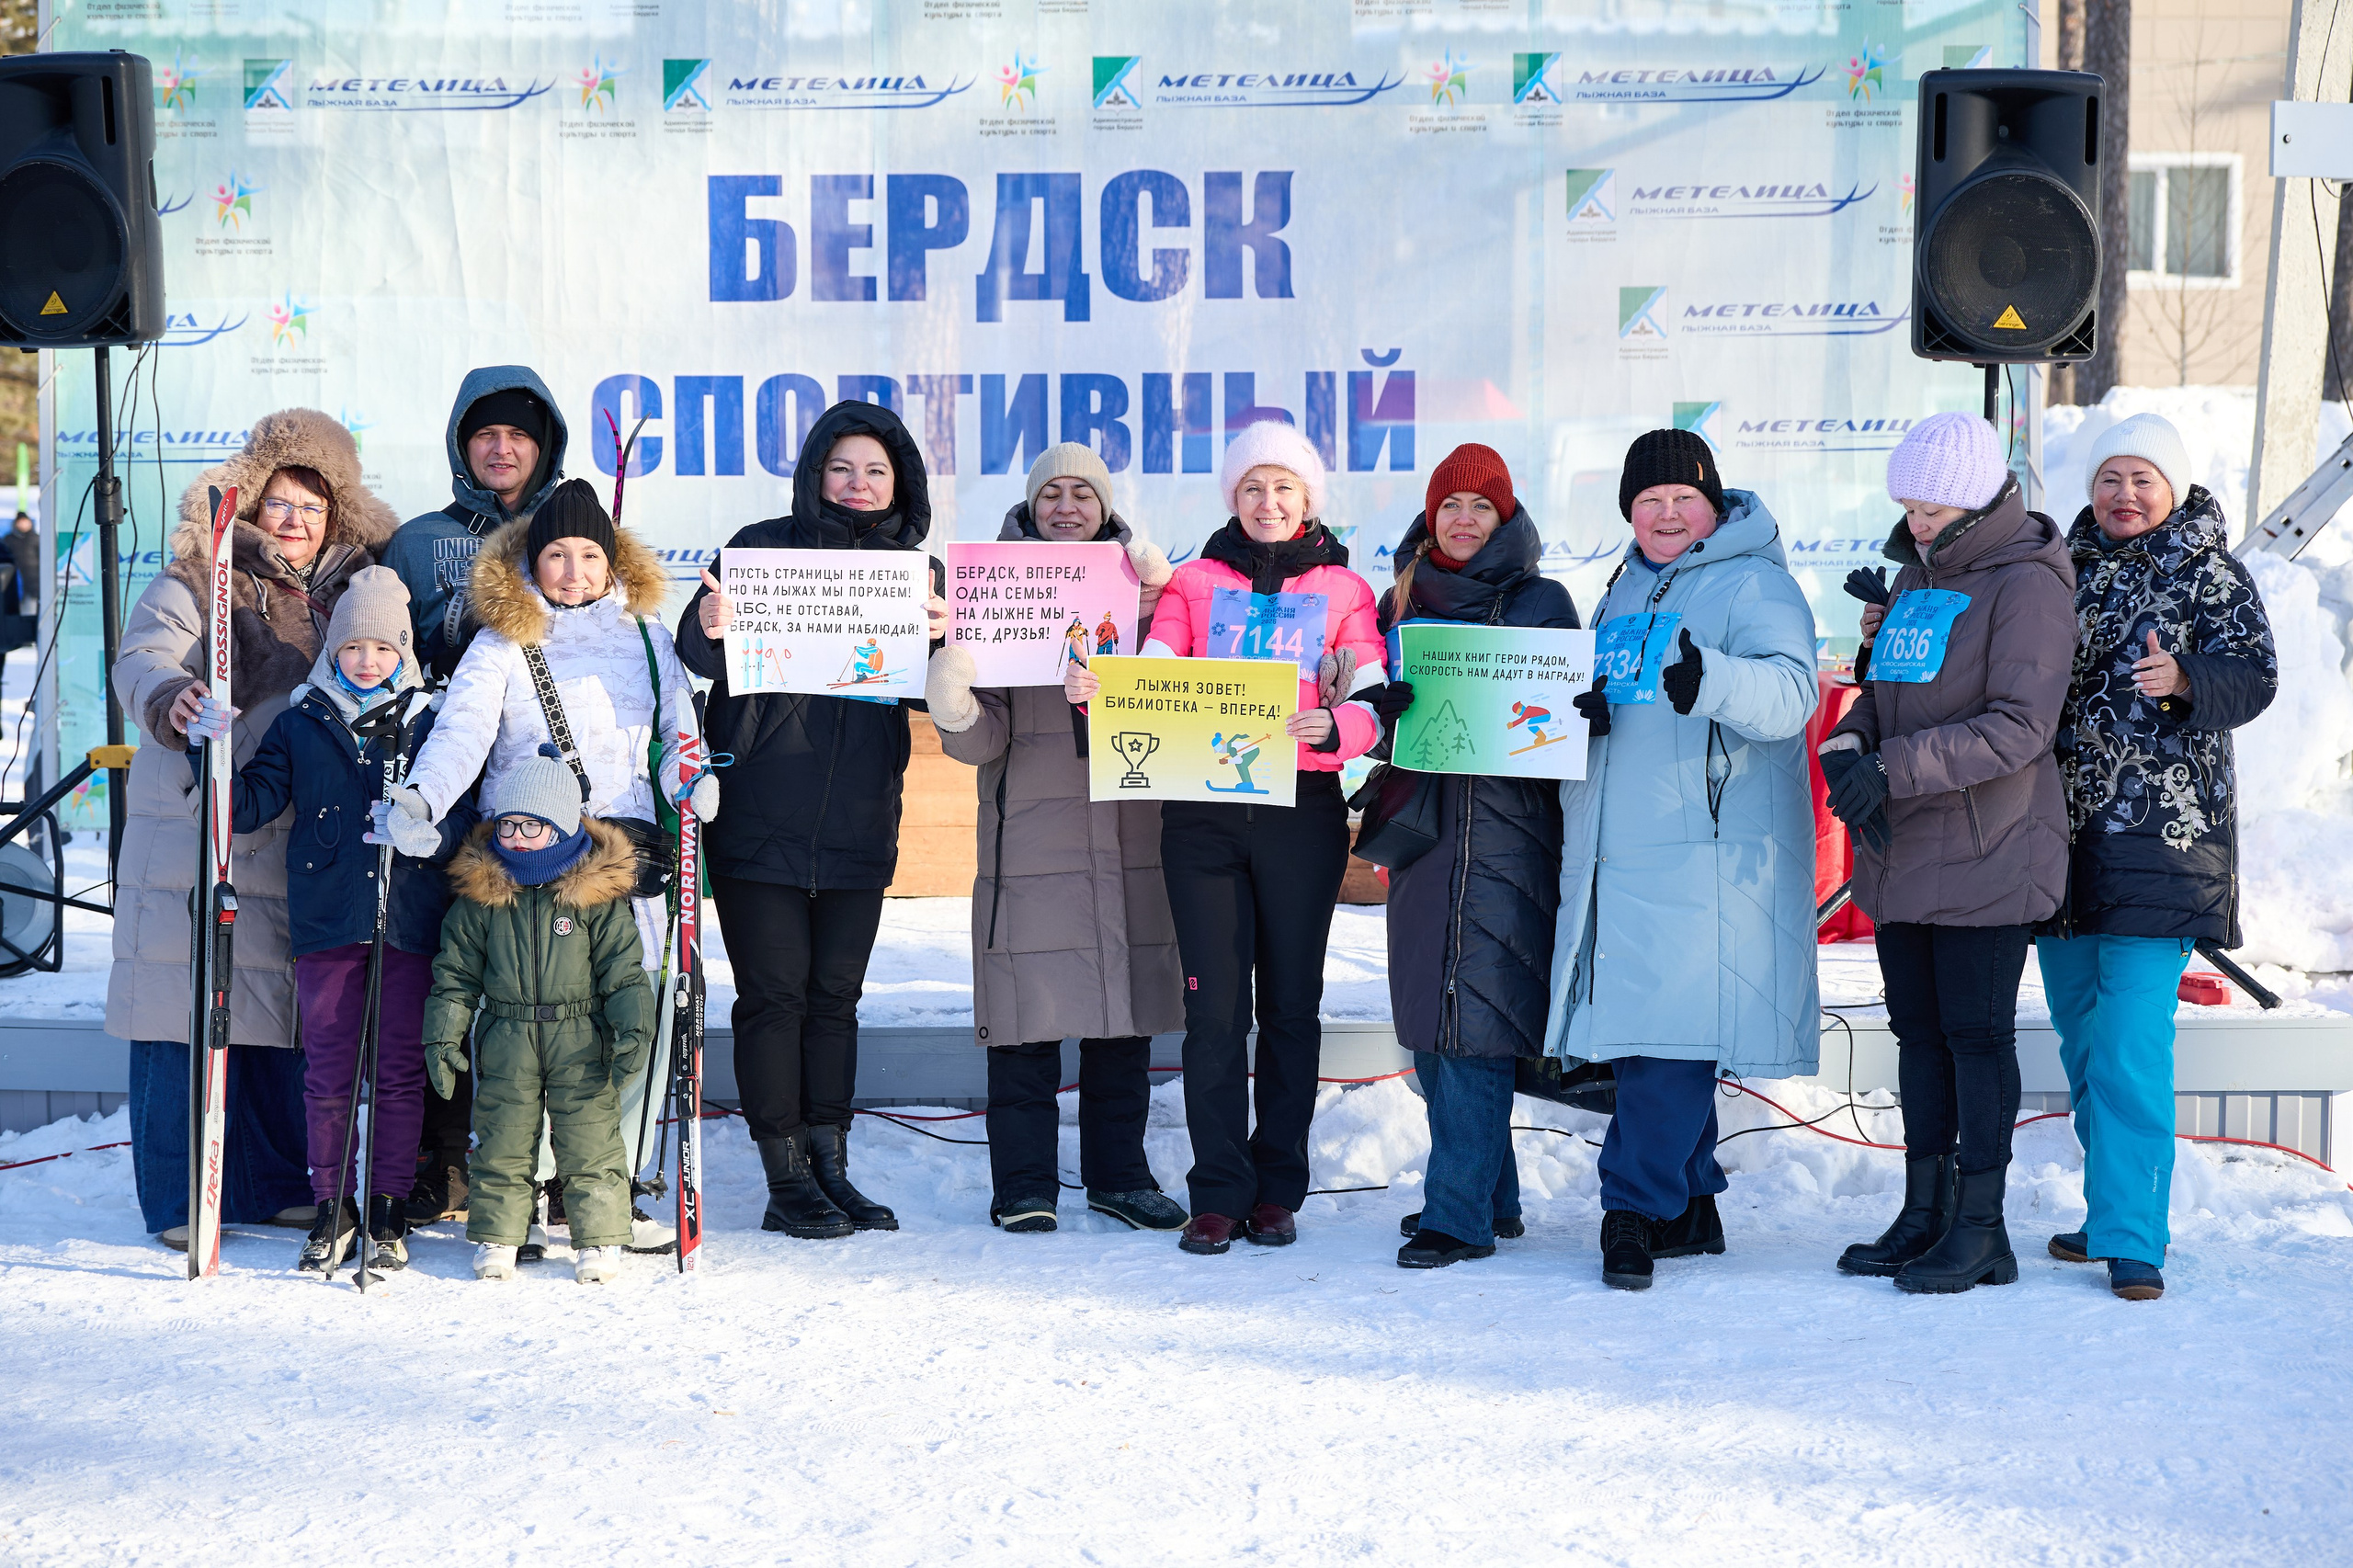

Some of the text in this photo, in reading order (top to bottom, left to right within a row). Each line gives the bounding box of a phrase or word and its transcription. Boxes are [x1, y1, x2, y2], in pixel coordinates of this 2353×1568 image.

[729, 74, 927, 91] МЕТЕЛИЦА
[1158, 71, 1358, 88] МЕТЕЛИЦА
[1579, 66, 1776, 85] МЕТЕЛИЦА
[309, 76, 507, 93] МЕТЕЛИЦА
[785, 97, 817, 106] БАЗА
[1214, 94, 1246, 102] БАЗА
[1634, 90, 1666, 98] БАЗА
[1631, 183, 1827, 201] МЕТЕЛИЦА
[708, 169, 1295, 323] БЕРДСК
[1684, 301, 1881, 318] МЕТЕЛИЦА
[1738, 419, 1913, 433] МЕТЕЛИЦ
[729, 567, 769, 579] ПУСТЬ
[775, 568, 843, 582] СТРАНИЦЫ
[848, 569, 864, 581] НЕ
[956, 566, 1086, 582] БЕРДСК, ВПЕРЕД!
[729, 584, 912, 598] НО НА ЛЫЖАХ МЫ ПОРХАЕМ!
[956, 586, 1057, 603] ОДНА СЕМЬЯ!
[777, 604, 792, 615] НЕ
[798, 604, 863, 619] ОТСТАВАЙ,
[956, 608, 976, 619] НА
[982, 608, 1034, 619] ЛЫЖНЕ
[1040, 608, 1064, 619] МЫ
[1261, 606, 1296, 614] ЛЫЖНЯ
[217, 559, 228, 682] ROSSIGNOL
[730, 620, 919, 637] БЕРДСК, ЗА НАМИ НАБЛЮДАЙ!
[956, 627, 1051, 643] ВСЕ, ДРУЗЬЯ!
[1229, 625, 1304, 658] 7144
[1882, 627, 1933, 660] 7636
[1422, 650, 1570, 668] НАШИХ КНИГ ГЕРОИ РЯДОМ,
[1409, 665, 1463, 677] СКОРОСТЬ
[1467, 667, 1489, 678] НАМ
[1492, 668, 1523, 681] ДАДУТ
[1527, 669, 1534, 680] В
[1537, 670, 1585, 683] НАГРАДУ!
[1135, 679, 1245, 697] ЛЫЖНЯ ЗОВЕТ!
[1105, 696, 1199, 713] БИБЛИОТЕКА
[1220, 702, 1280, 720] ВПЕРЕД!
[681, 807, 697, 925] NORDWAY
[682, 1141, 691, 1188] JUNIOR
[684, 1191, 696, 1222] XC
